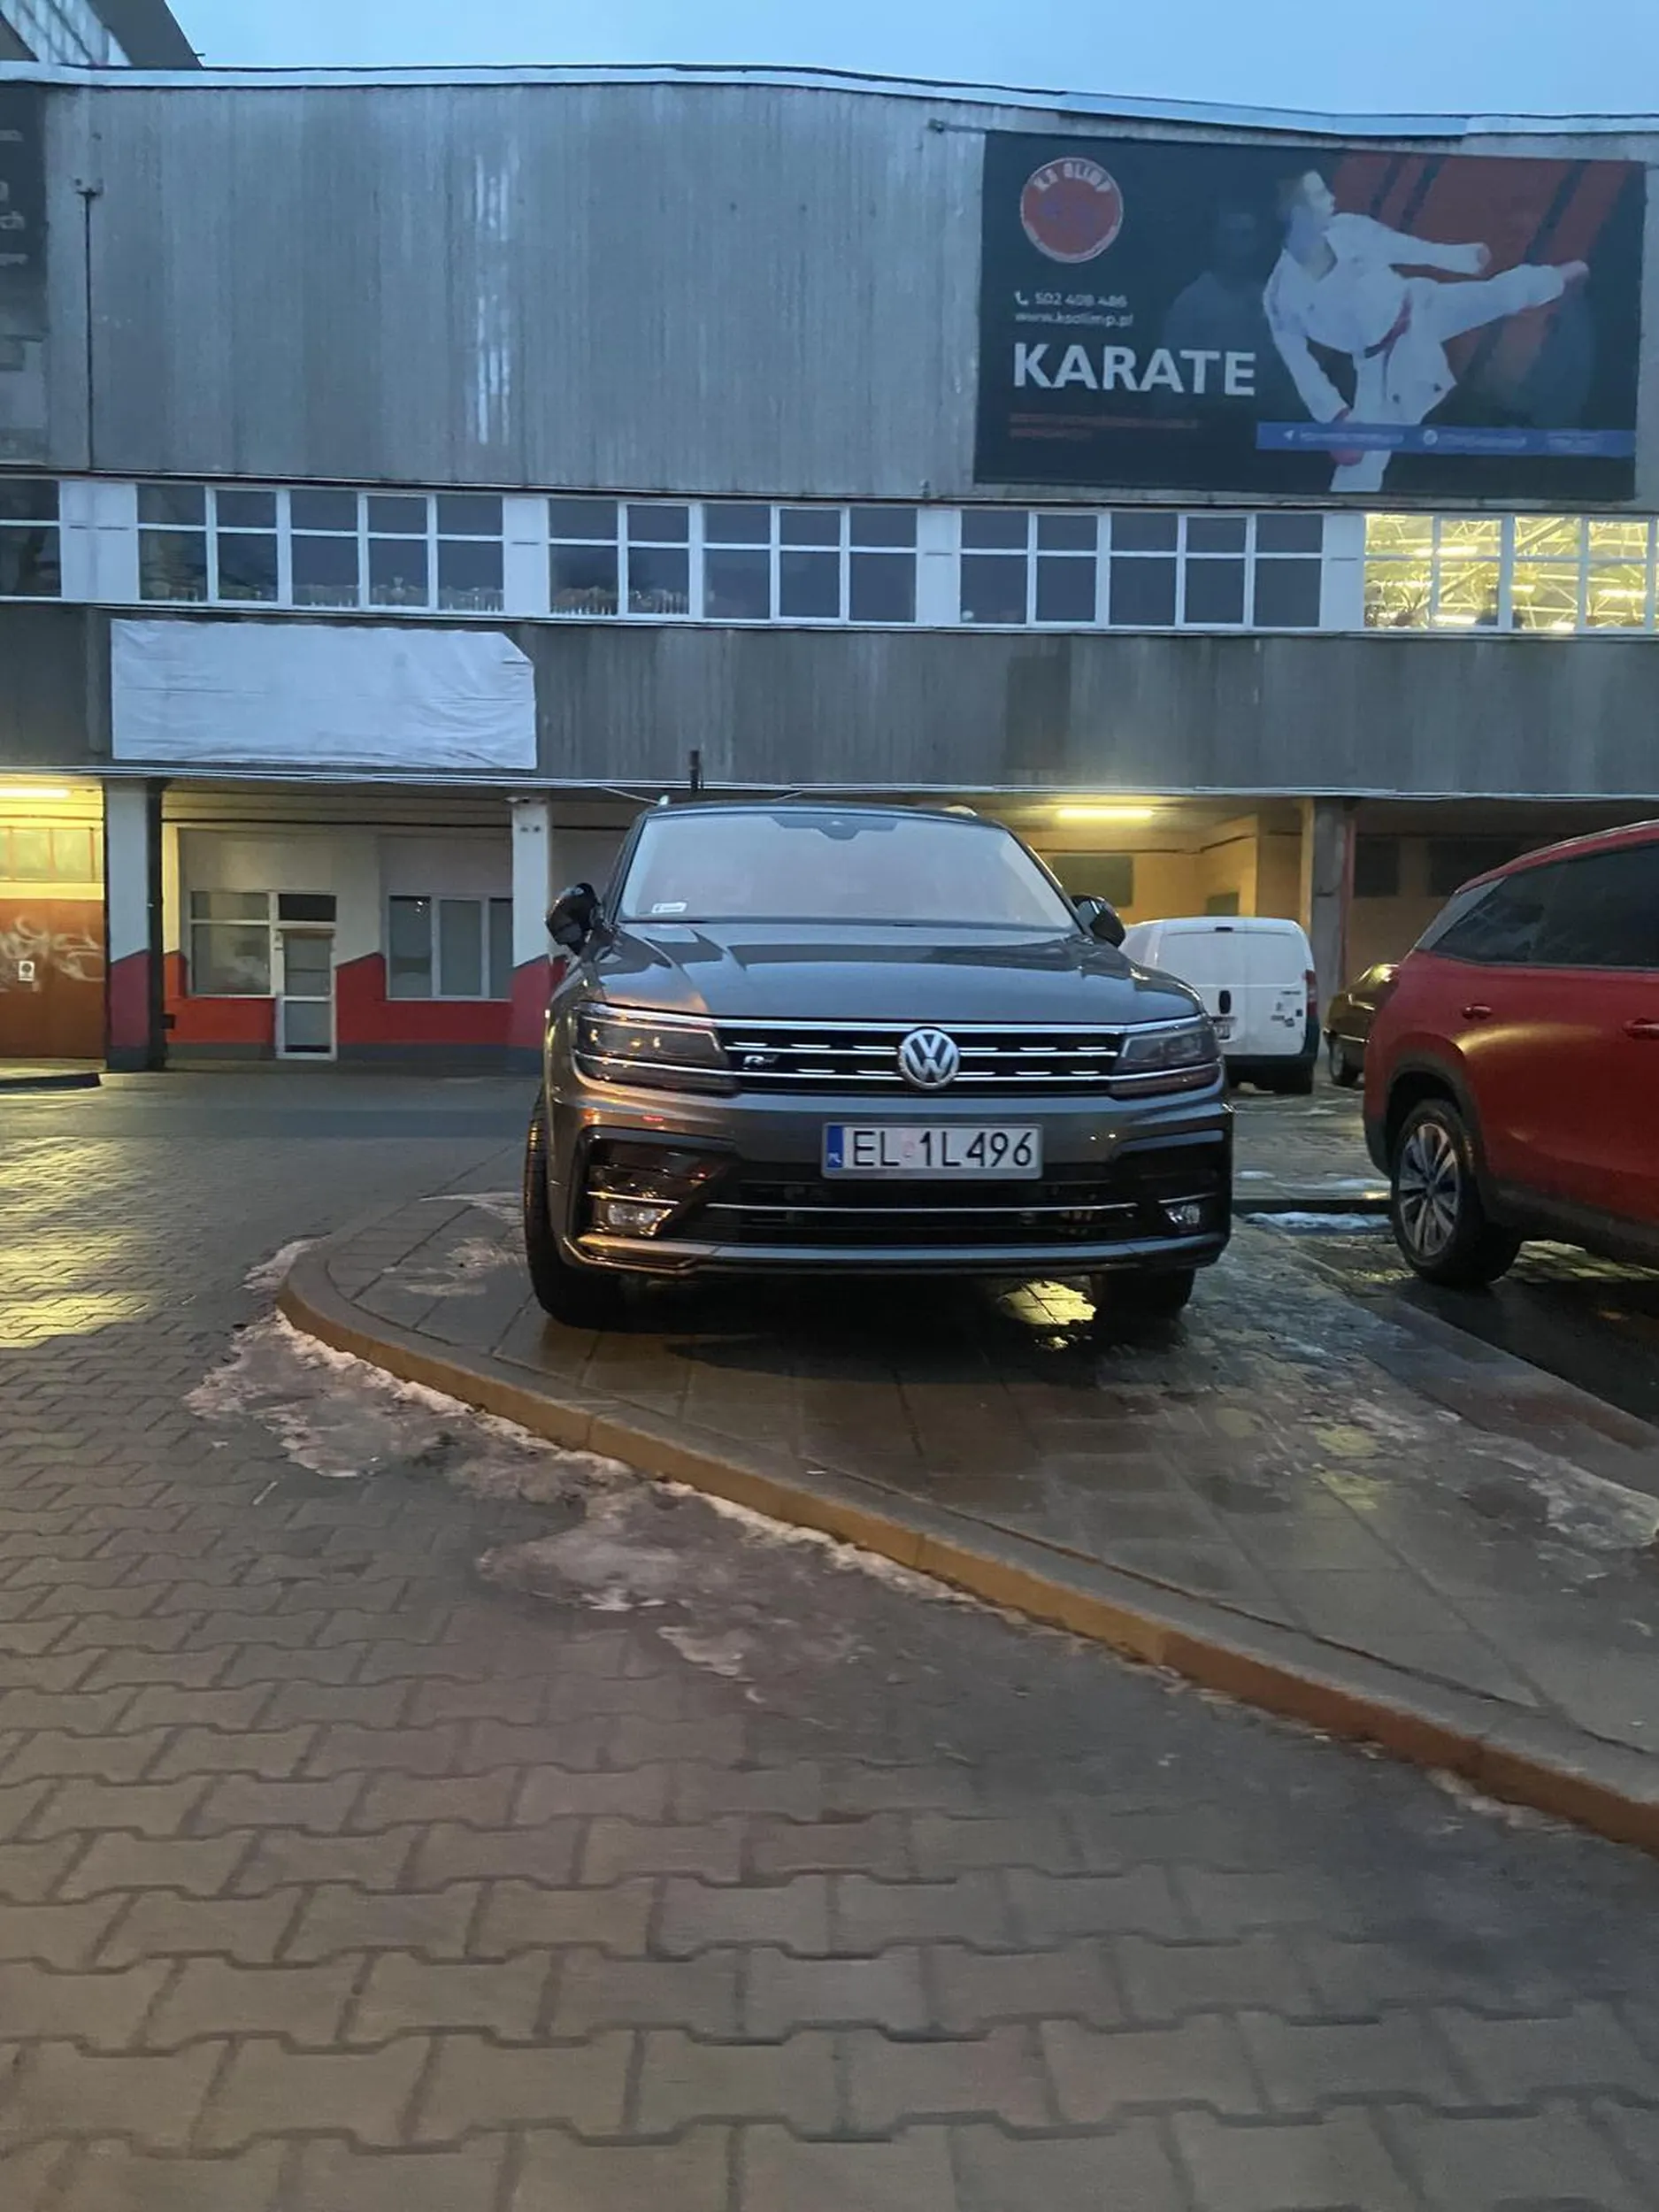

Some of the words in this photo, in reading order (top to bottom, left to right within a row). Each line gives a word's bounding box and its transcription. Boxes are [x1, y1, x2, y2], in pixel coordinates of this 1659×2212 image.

[1014, 342, 1256, 396] KARATE
[853, 1130, 900, 1167] EL
[919, 1131, 1033, 1167] 1L496
